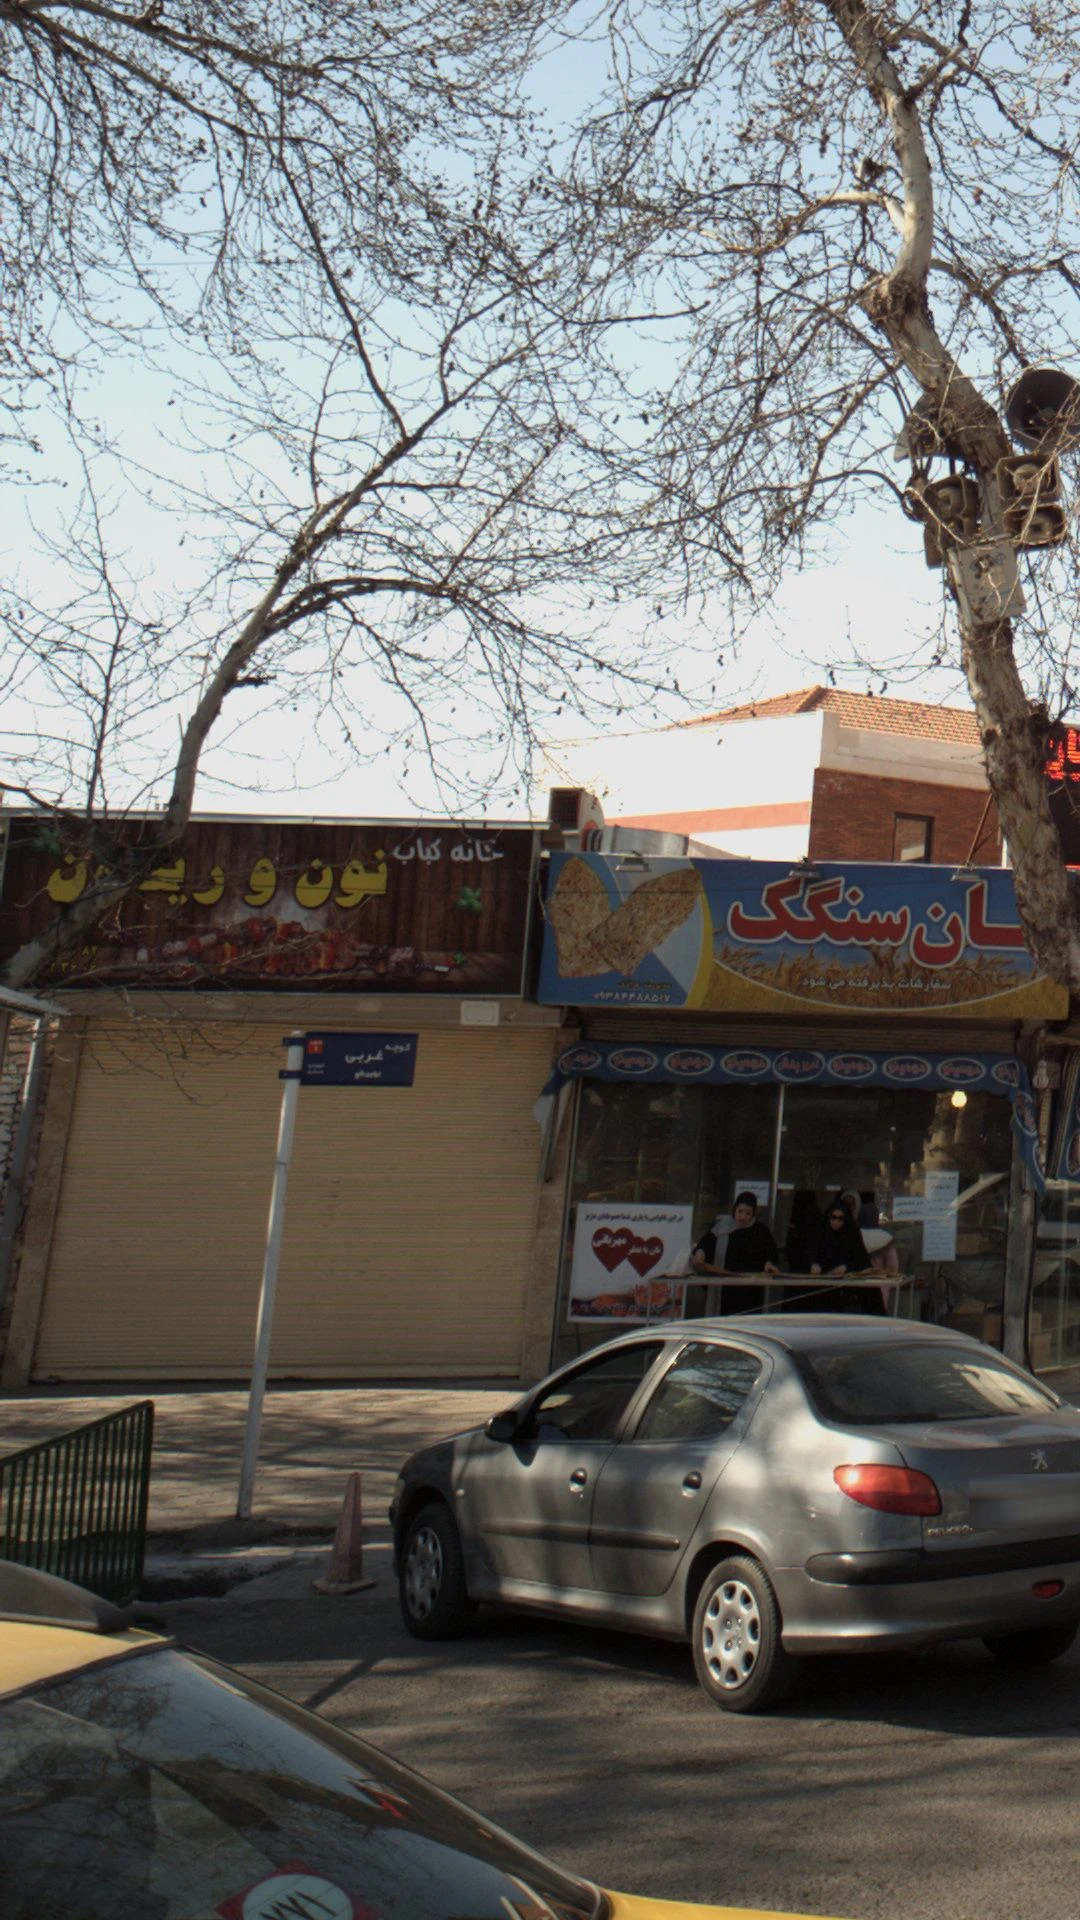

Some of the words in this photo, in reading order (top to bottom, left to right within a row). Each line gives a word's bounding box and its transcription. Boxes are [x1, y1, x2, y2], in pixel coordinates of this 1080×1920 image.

[392, 837, 441, 865] کباب
[450, 838, 505, 862] خانه
[46, 853, 225, 905] ریحن
[242, 856, 278, 908] و
[294, 848, 388, 909] نون
[727, 876, 911, 946] سنگک
[801, 976, 826, 989] شود
[828, 977, 845, 990] می
[848, 975, 896, 992] پذیرفته
[898, 976, 952, 992] سفارشات
[345, 1049, 384, 1064] غربی
[385, 1043, 411, 1055] کوچه
